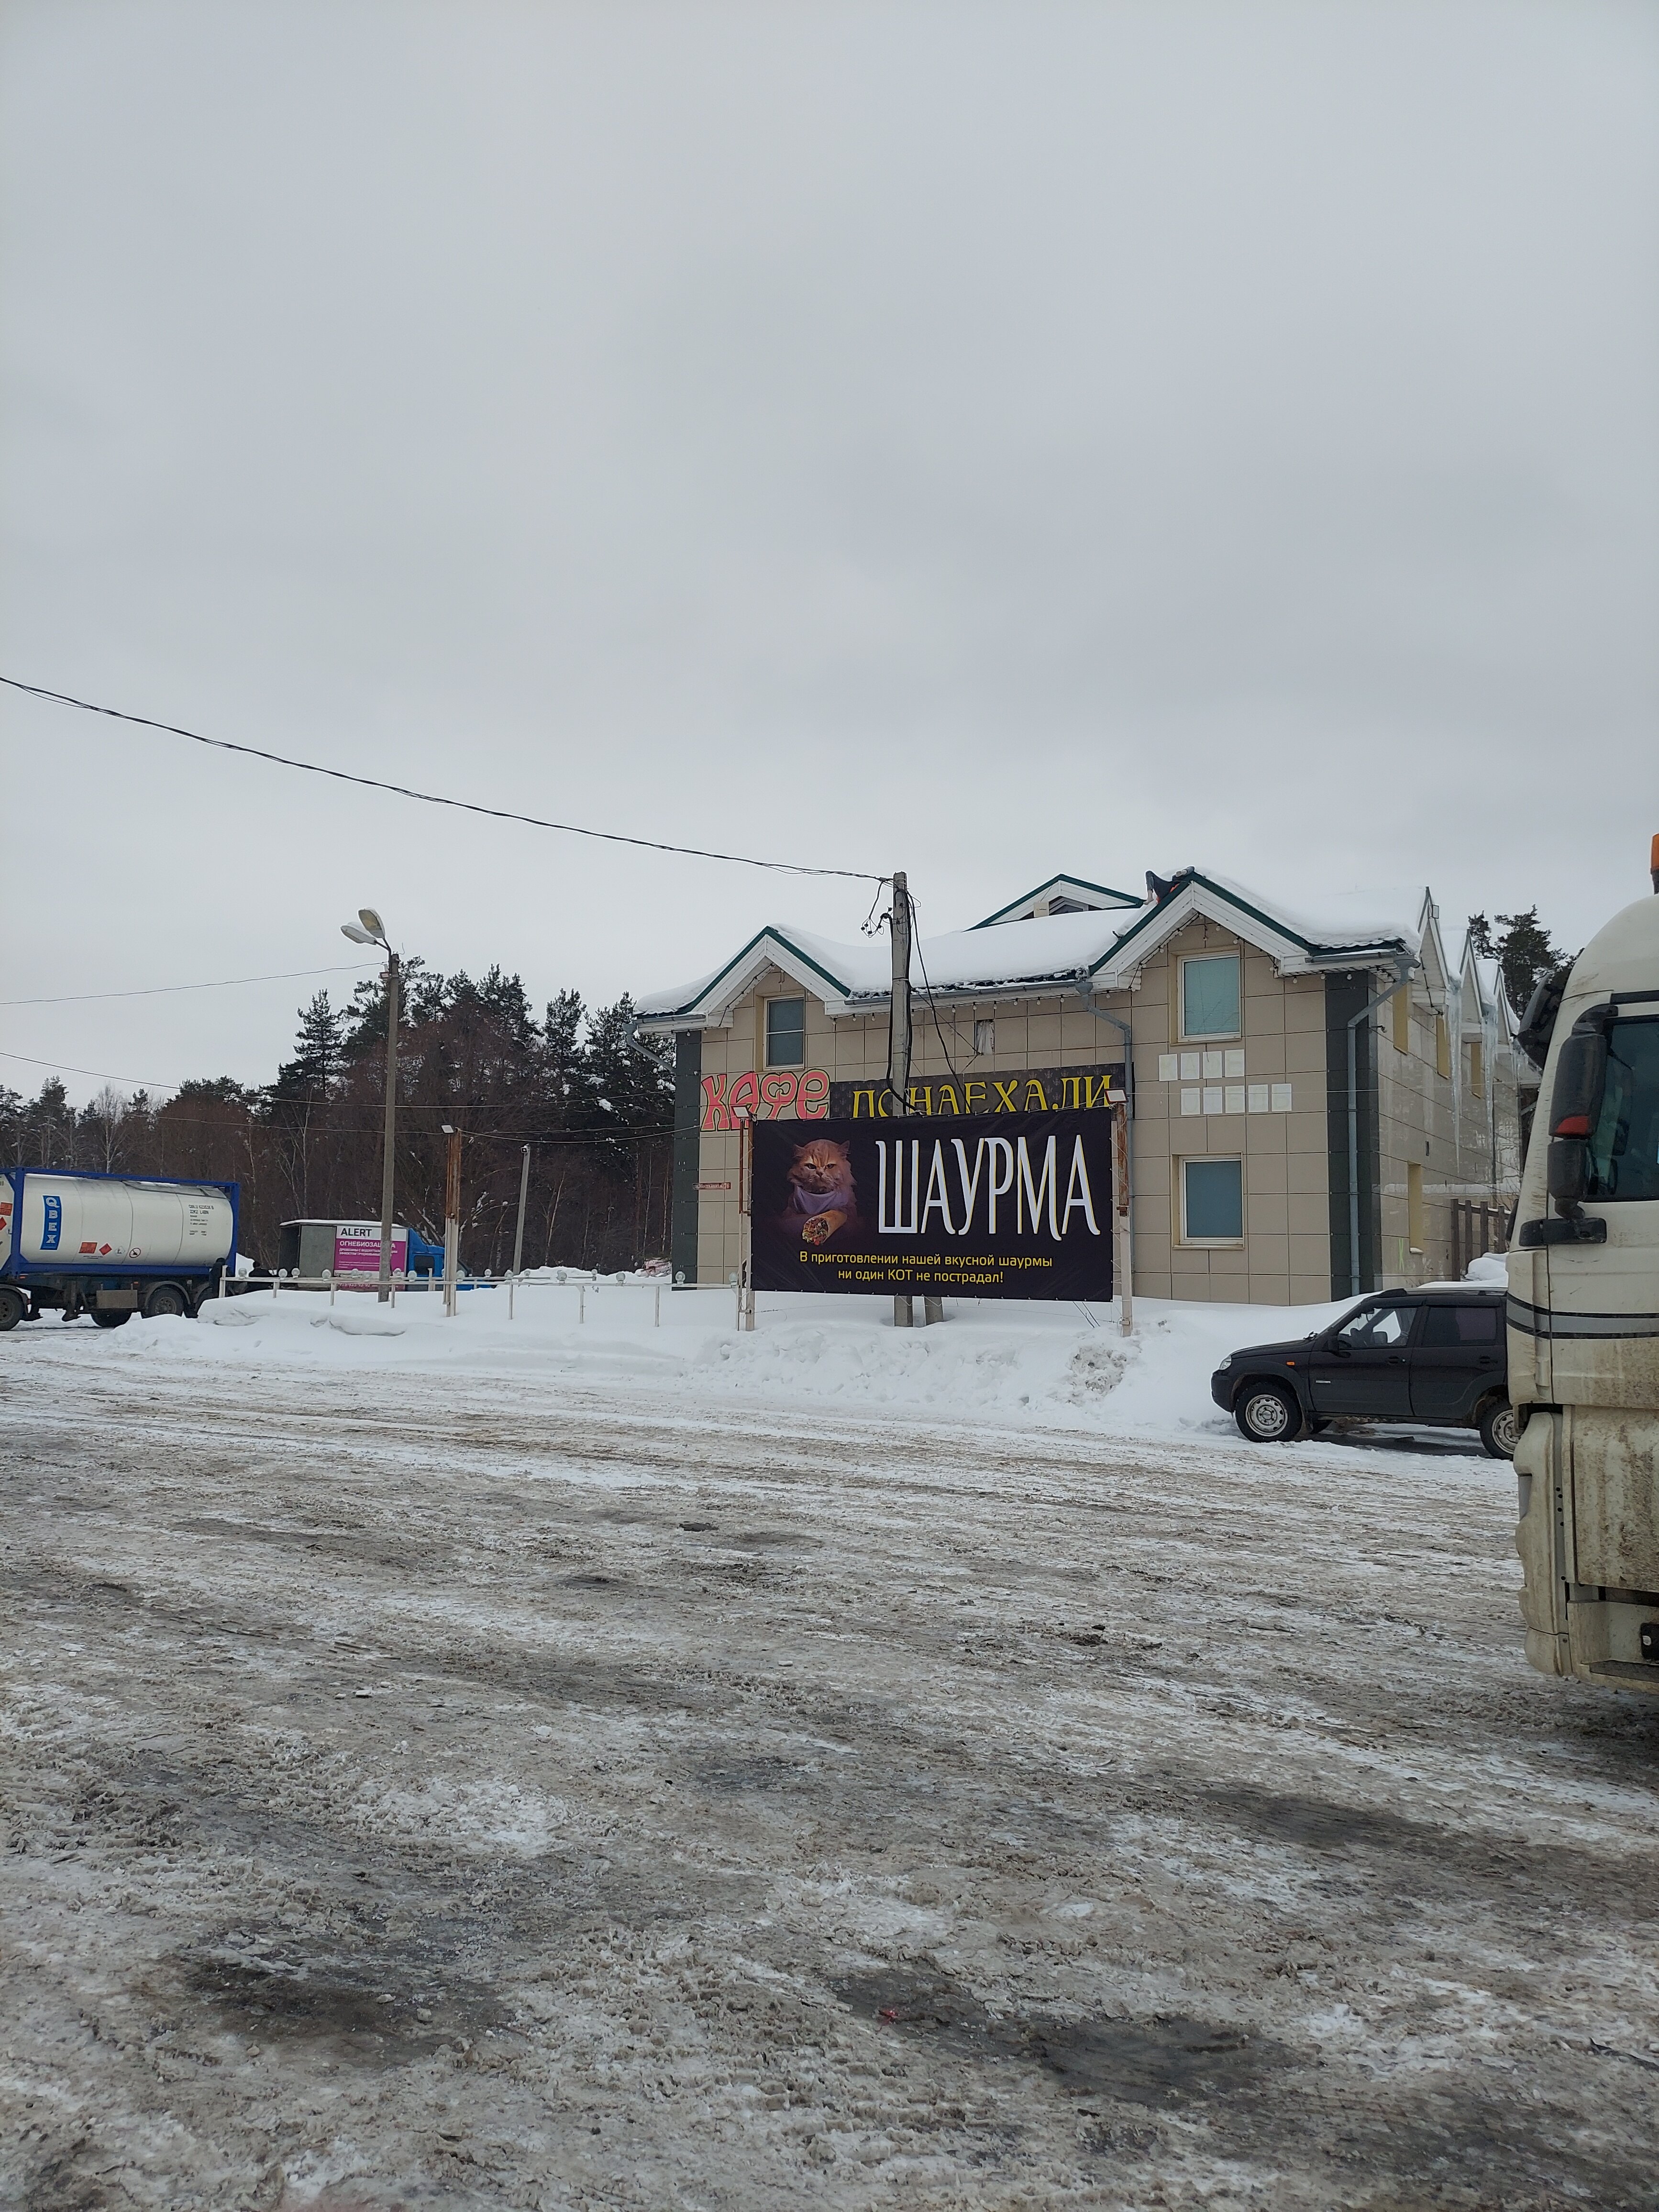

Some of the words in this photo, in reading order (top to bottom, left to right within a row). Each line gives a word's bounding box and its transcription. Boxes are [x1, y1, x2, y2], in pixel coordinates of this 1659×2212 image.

[700, 1069, 830, 1132] КАФЕ
[875, 1135, 1100, 1240] ШАУРМА
[46, 1197, 60, 1243] QBEX
[341, 1228, 372, 1237] ALERT
[800, 1251, 808, 1262] В
[811, 1253, 898, 1264] приготовлении
[902, 1253, 940, 1265] нашей
[945, 1254, 994, 1268] вкусной
[999, 1257, 1052, 1269] шаурмы
[838, 1270, 852, 1279] ни
[855, 1270, 884, 1282] один
[888, 1269, 913, 1281] КОТ
[916, 1272, 930, 1281] не
[934, 1272, 1003, 1285] пострадал!
